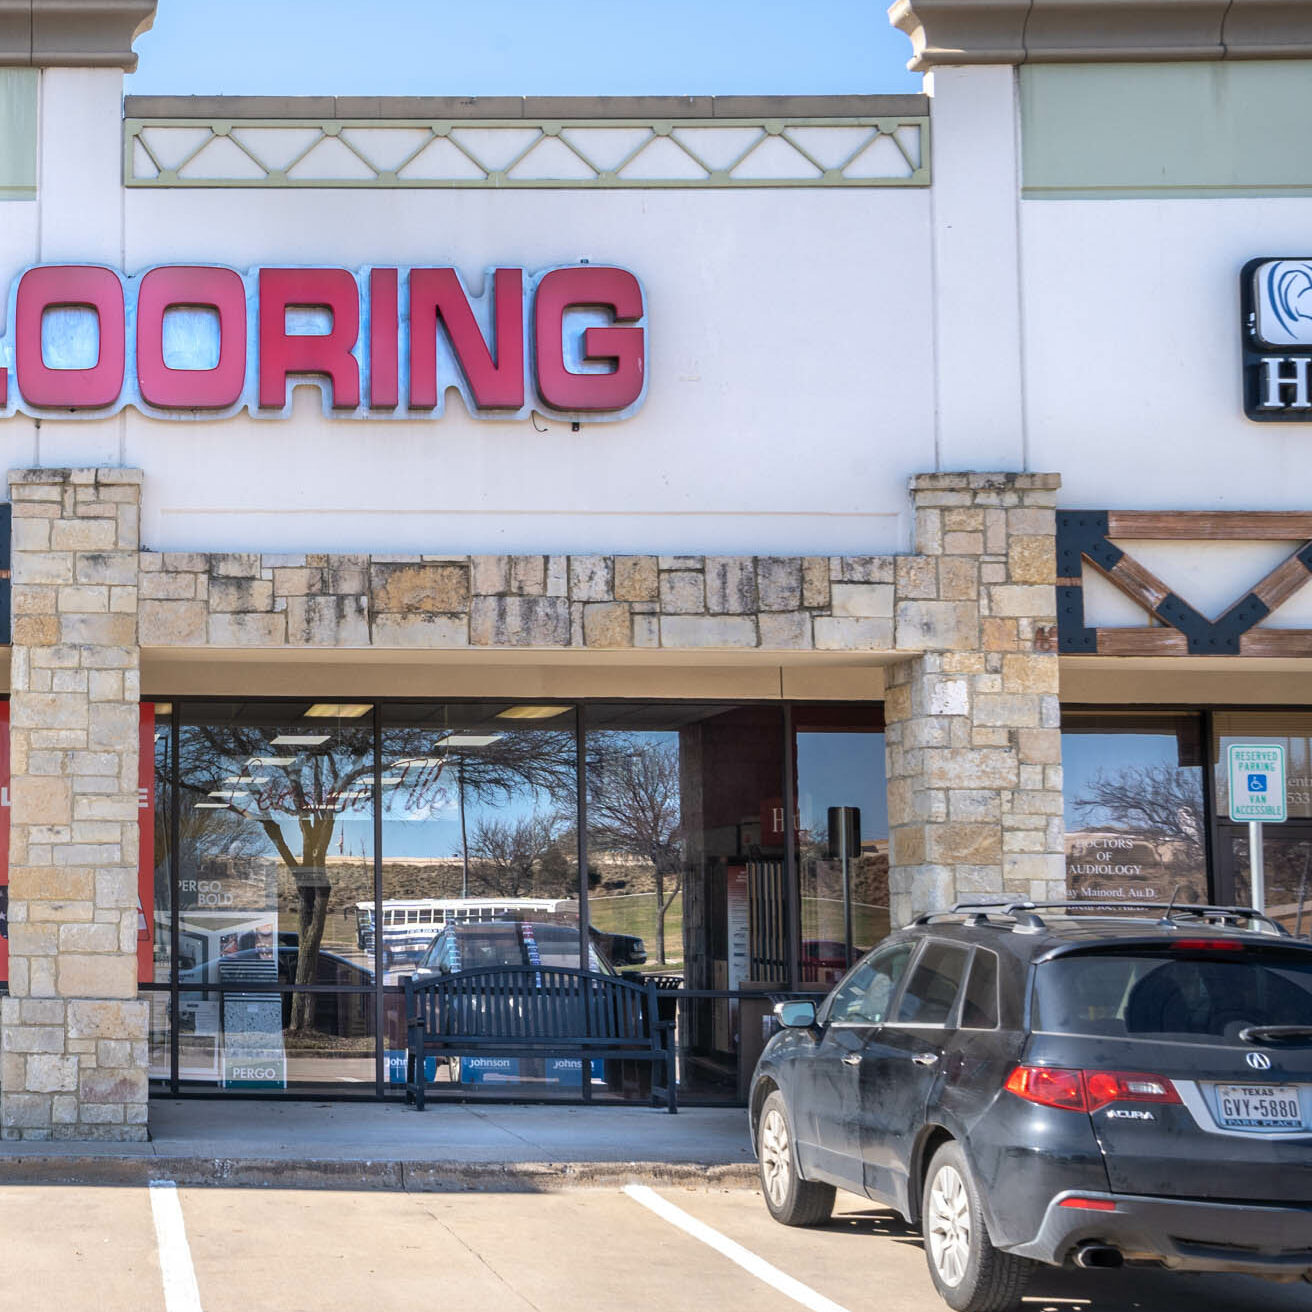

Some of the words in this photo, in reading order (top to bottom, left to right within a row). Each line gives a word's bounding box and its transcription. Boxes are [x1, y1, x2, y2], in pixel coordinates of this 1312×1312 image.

[1235, 751, 1278, 761] RESERVED
[1238, 762, 1276, 772] PARKING
[1248, 794, 1267, 804] VAN
[1235, 805, 1282, 816] ACCESSIBLE
[1075, 839, 1134, 849] DOCTORS
[1096, 851, 1113, 862] OF
[1069, 864, 1142, 875] AUDIOLOGY
[198, 893, 234, 905] BOLD
[232, 1067, 276, 1079] PERGO
[1241, 1087, 1274, 1097] TEXAS
[1106, 1110, 1155, 1120] ACURA
